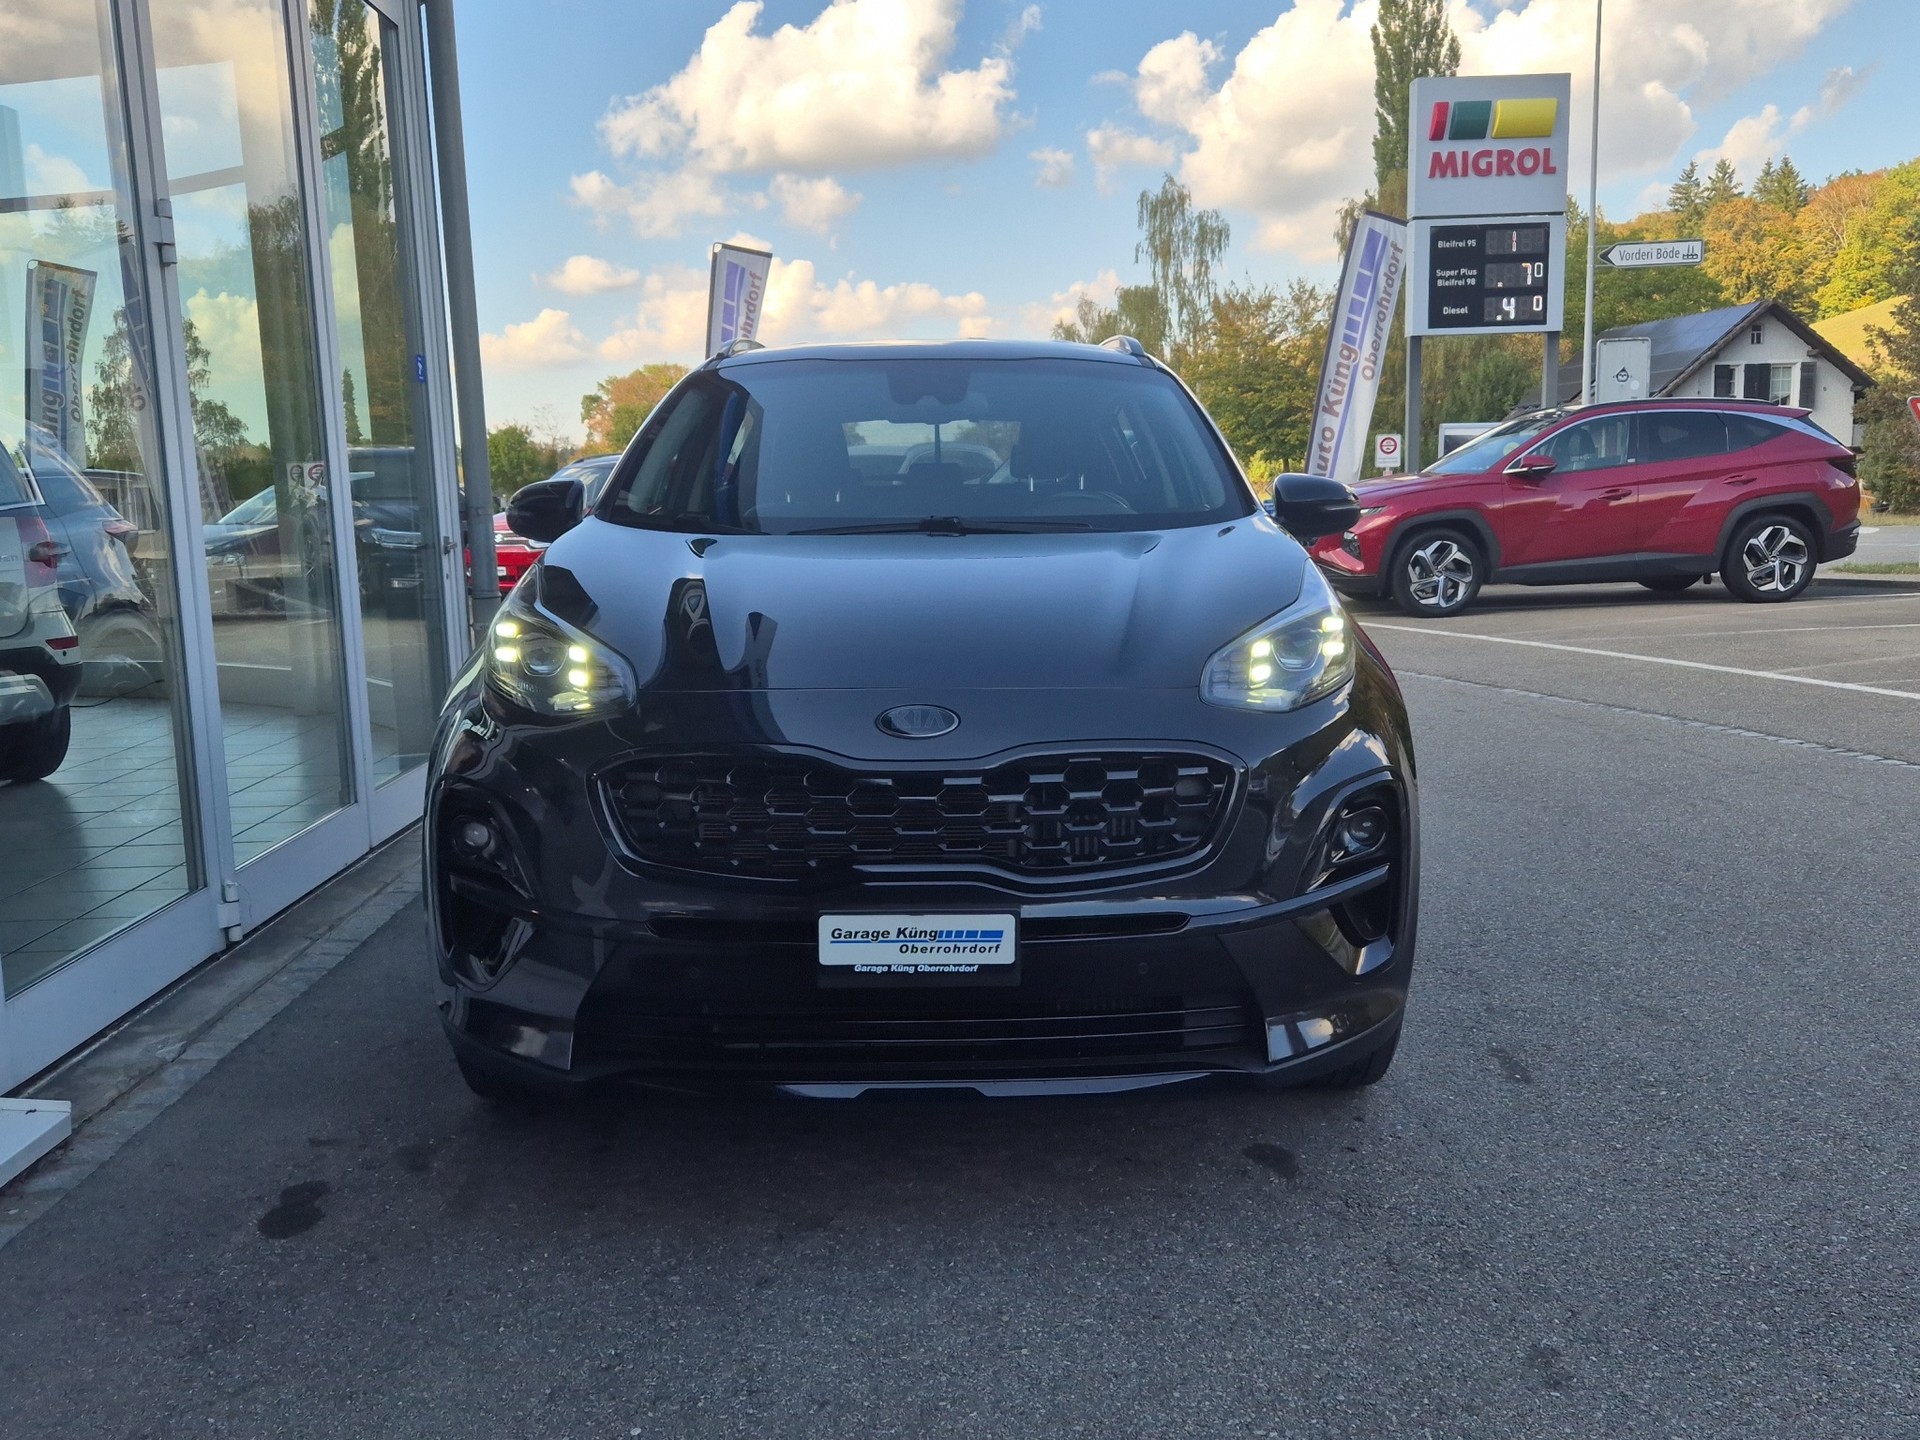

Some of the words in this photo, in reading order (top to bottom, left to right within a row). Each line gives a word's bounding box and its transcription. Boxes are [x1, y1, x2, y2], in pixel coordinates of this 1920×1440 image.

[1429, 148, 1557, 179] MIGROL
[1437, 240, 1466, 248] Bleifrei
[1467, 239, 1477, 247] 95
[1619, 248, 1653, 261] Vorderi
[1656, 246, 1680, 260] Böde
[1436, 269, 1460, 278] Super
[1460, 268, 1478, 276] Plus
[1437, 279, 1465, 287] Bleifrei
[1466, 278, 1476, 286] 98
[1361, 240, 1404, 381] Oberrohrdorf
[1443, 306, 1469, 315] Diesel
[1322, 344, 1359, 418] Küng
[831, 927, 890, 941] Garage
[896, 927, 939, 942] Küng
[898, 943, 1001, 954] Oberrohrdorf
[854, 964, 888, 974] Garage
[890, 963, 915, 974] Küng
[917, 964, 978, 973] Oberrohrdorf
